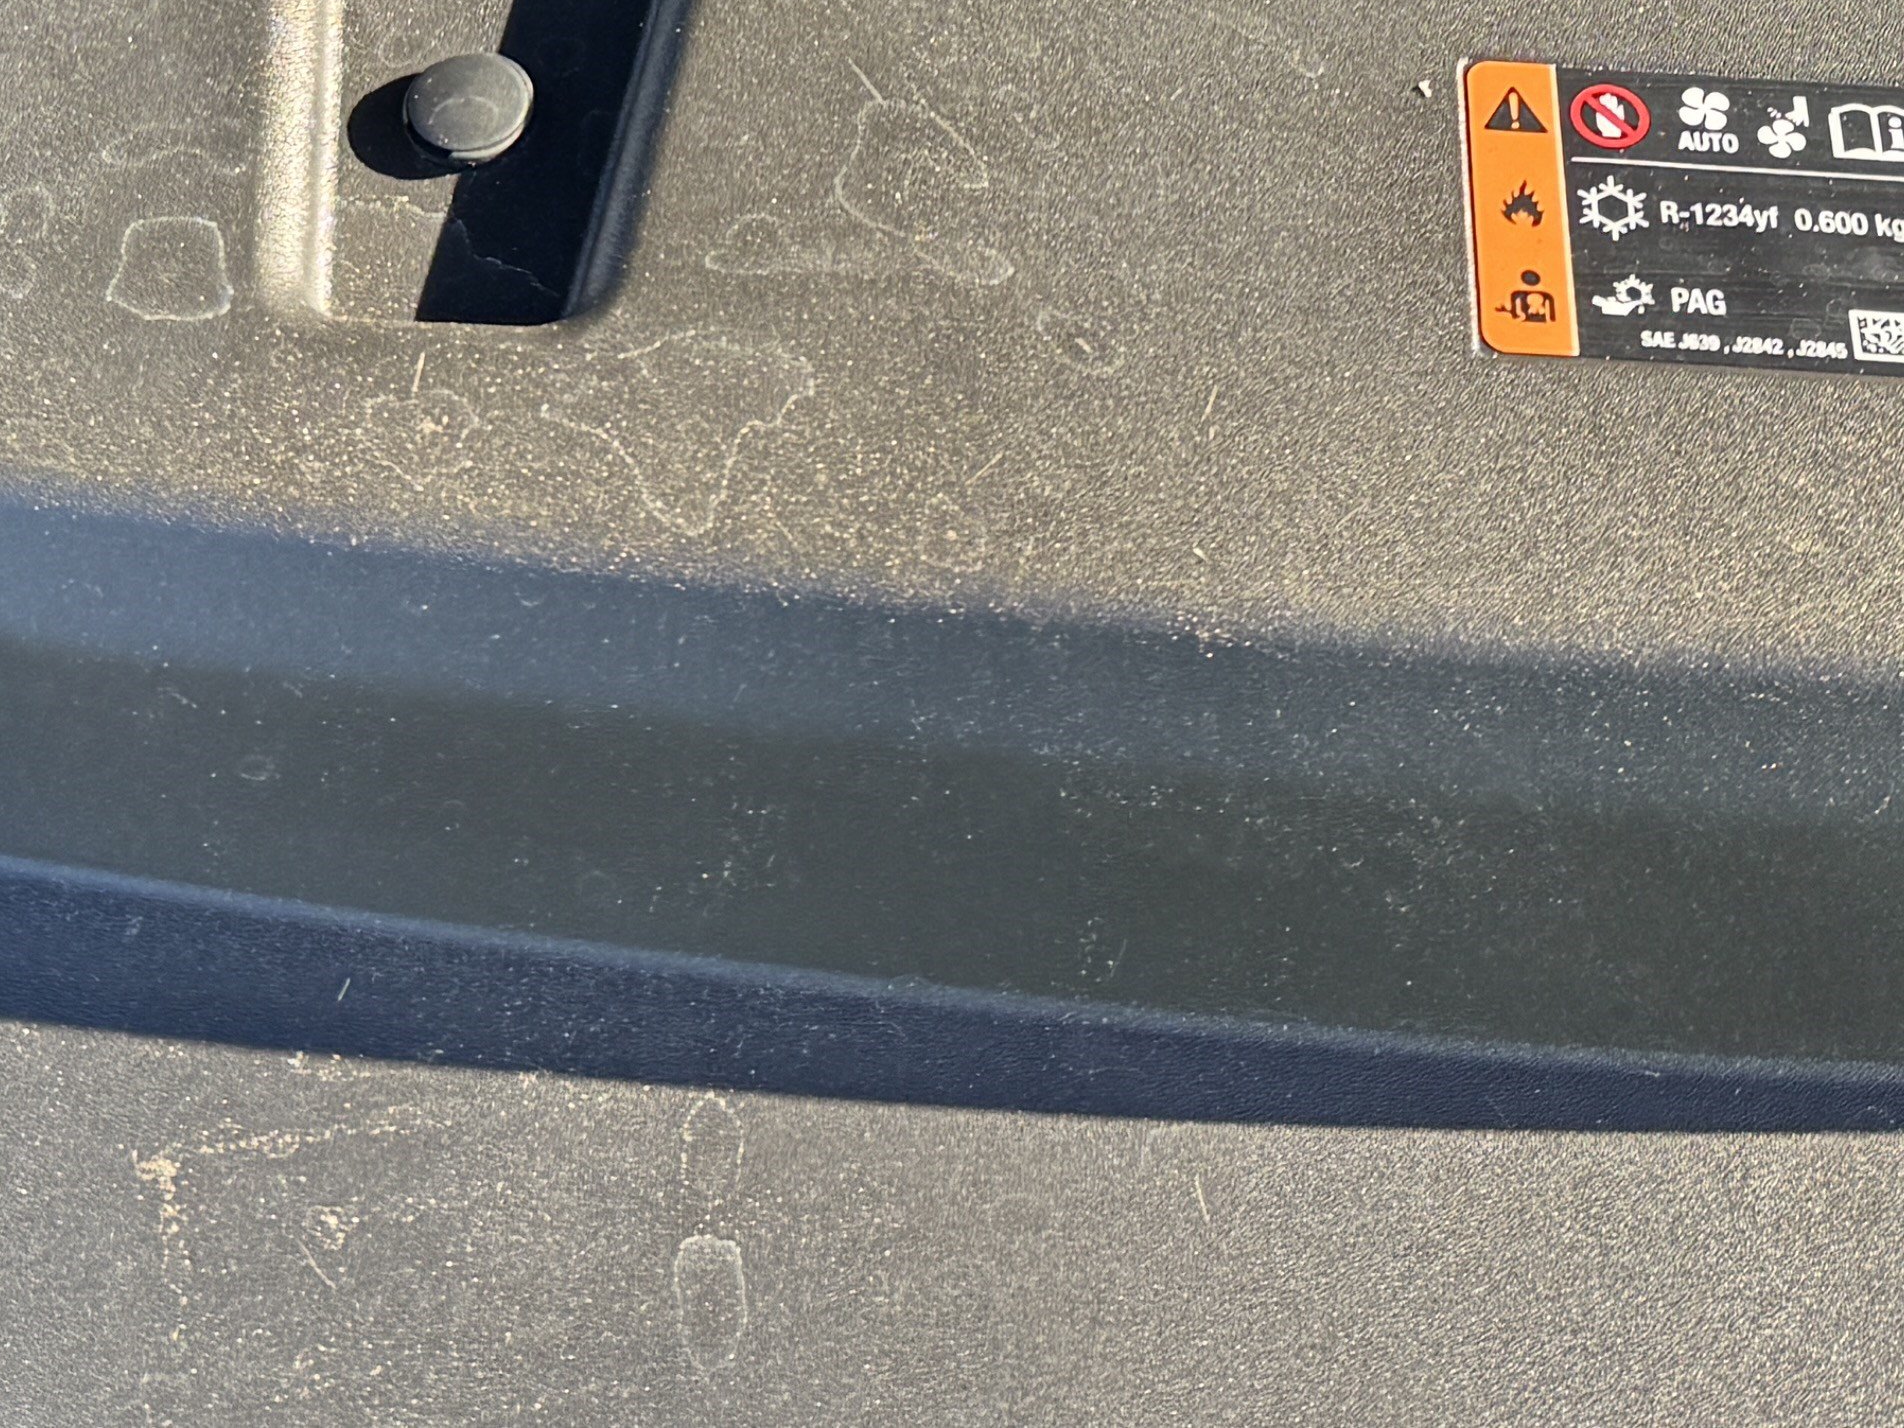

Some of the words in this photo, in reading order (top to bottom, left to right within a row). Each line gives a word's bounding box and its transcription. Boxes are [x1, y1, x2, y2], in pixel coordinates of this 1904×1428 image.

[1677, 130, 1740, 154] AUTO
[1659, 200, 1779, 233] R-1234yf
[1793, 207, 1869, 236] 0.600
[1670, 286, 1727, 316] PAG
[1640, 329, 1676, 349] SAE
